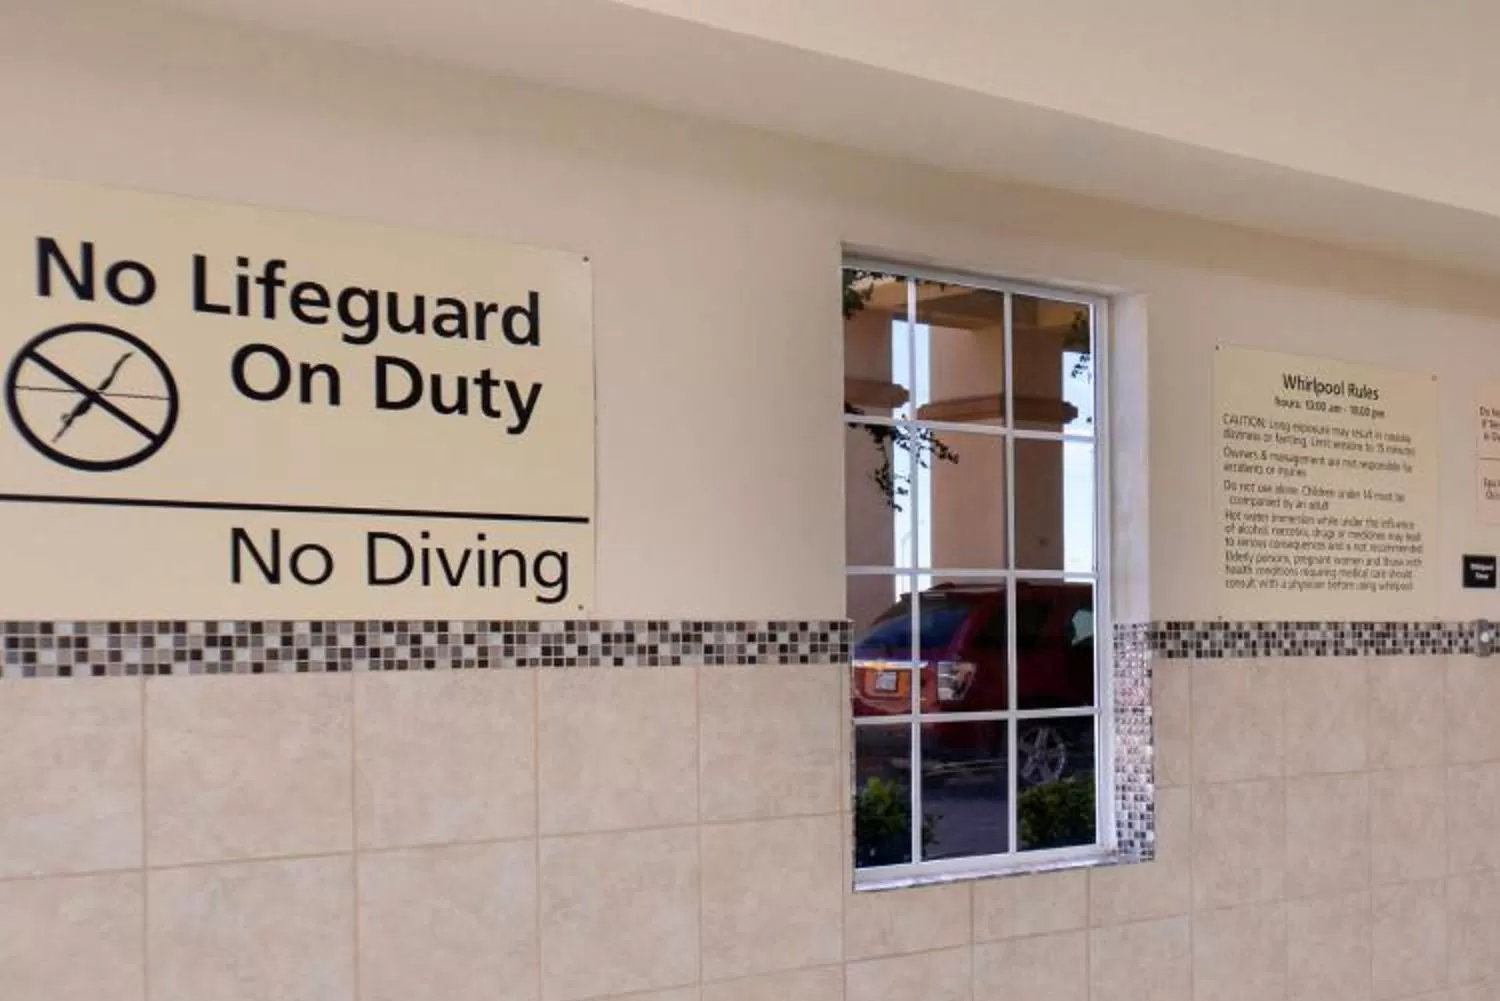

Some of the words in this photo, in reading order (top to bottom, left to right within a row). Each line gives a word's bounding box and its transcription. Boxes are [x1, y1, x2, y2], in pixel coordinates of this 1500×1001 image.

[35, 235, 158, 307] No
[191, 252, 542, 347] Lifeguard
[230, 342, 342, 407] On
[373, 354, 544, 436] Duty
[1282, 373, 1345, 397] Whirlpool
[1347, 382, 1380, 401] Rules
[1223, 479, 1237, 491] Do
[230, 526, 335, 586] No
[365, 530, 570, 604] Diving
